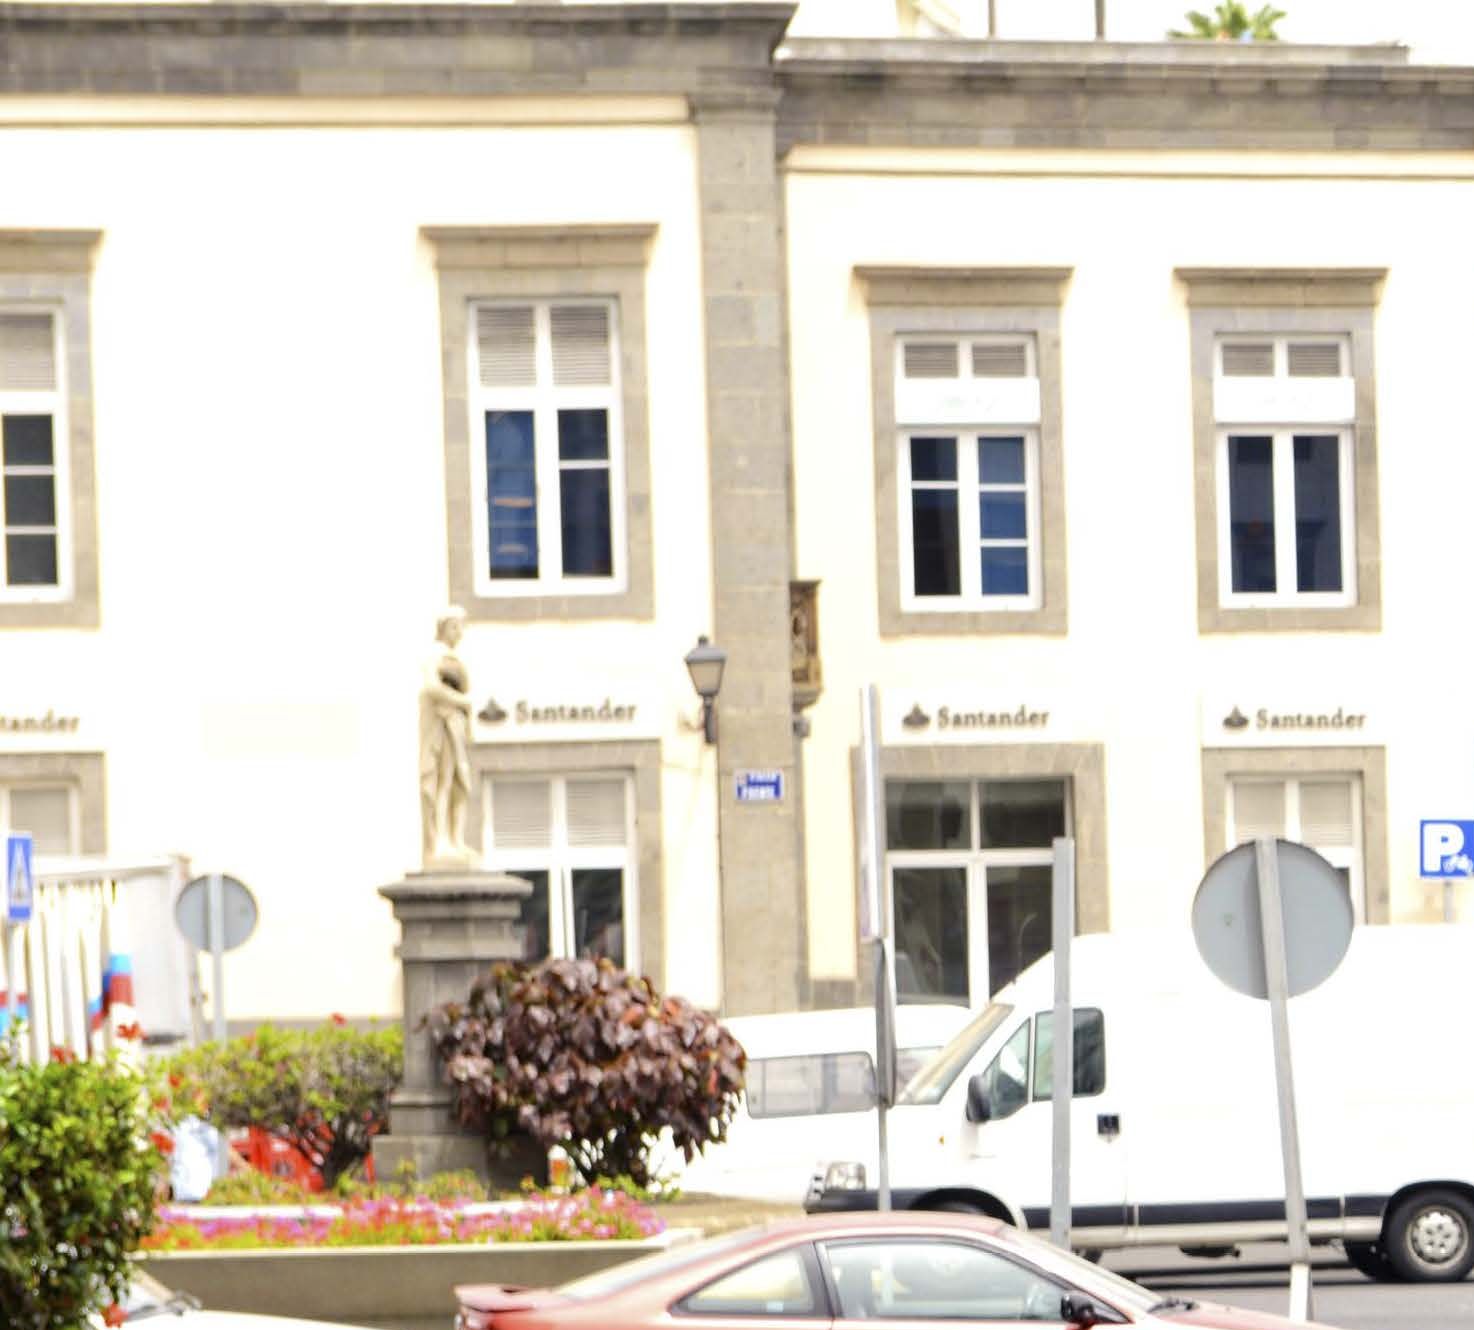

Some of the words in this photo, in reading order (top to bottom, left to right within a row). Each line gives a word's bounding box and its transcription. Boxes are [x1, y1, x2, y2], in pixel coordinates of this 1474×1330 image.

[516, 697, 637, 725] Santander
[937, 703, 1050, 730] Santander
[1256, 706, 1366, 731] Santander
[1422, 823, 1465, 873] P
